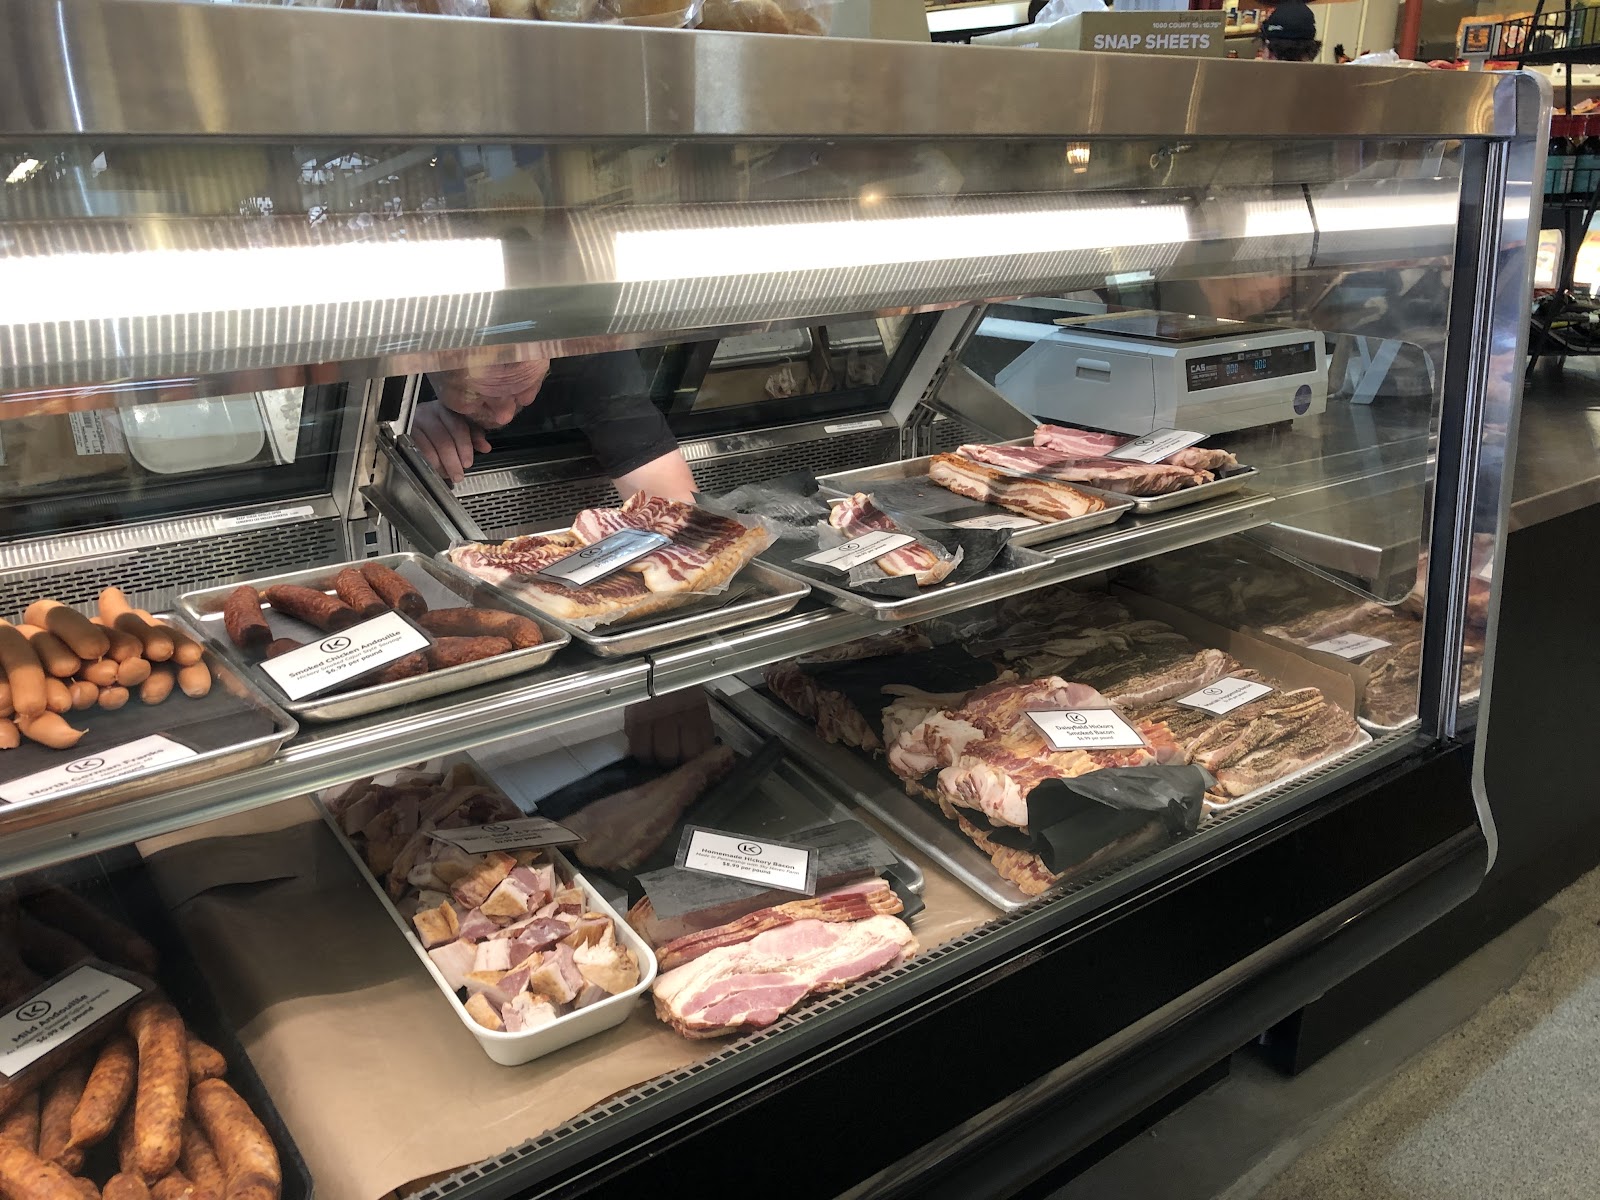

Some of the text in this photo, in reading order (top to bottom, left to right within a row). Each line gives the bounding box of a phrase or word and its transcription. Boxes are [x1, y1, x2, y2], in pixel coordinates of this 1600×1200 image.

[1093, 34, 1210, 50] SNAP SHEETS
[1190, 363, 1206, 373] CAS
[289, 632, 400, 677] Smoked Chicken Andouille
[297, 636, 402, 680] Hickory Smoked Cajun Style Sausage
[326, 664, 346, 674] $6.99
[361, 649, 383, 661] pound
[29, 782, 68, 796] North
[71, 764, 121, 782] German
[123, 749, 164, 764] Franks
[702, 848, 795, 870] Homemade Hickory Bacon
[717, 856, 747, 865] Partnership
[12, 995, 87, 1042] Mild Andouille
[59, 1021, 71, 1030] per
[72, 1006, 94, 1022] pound
